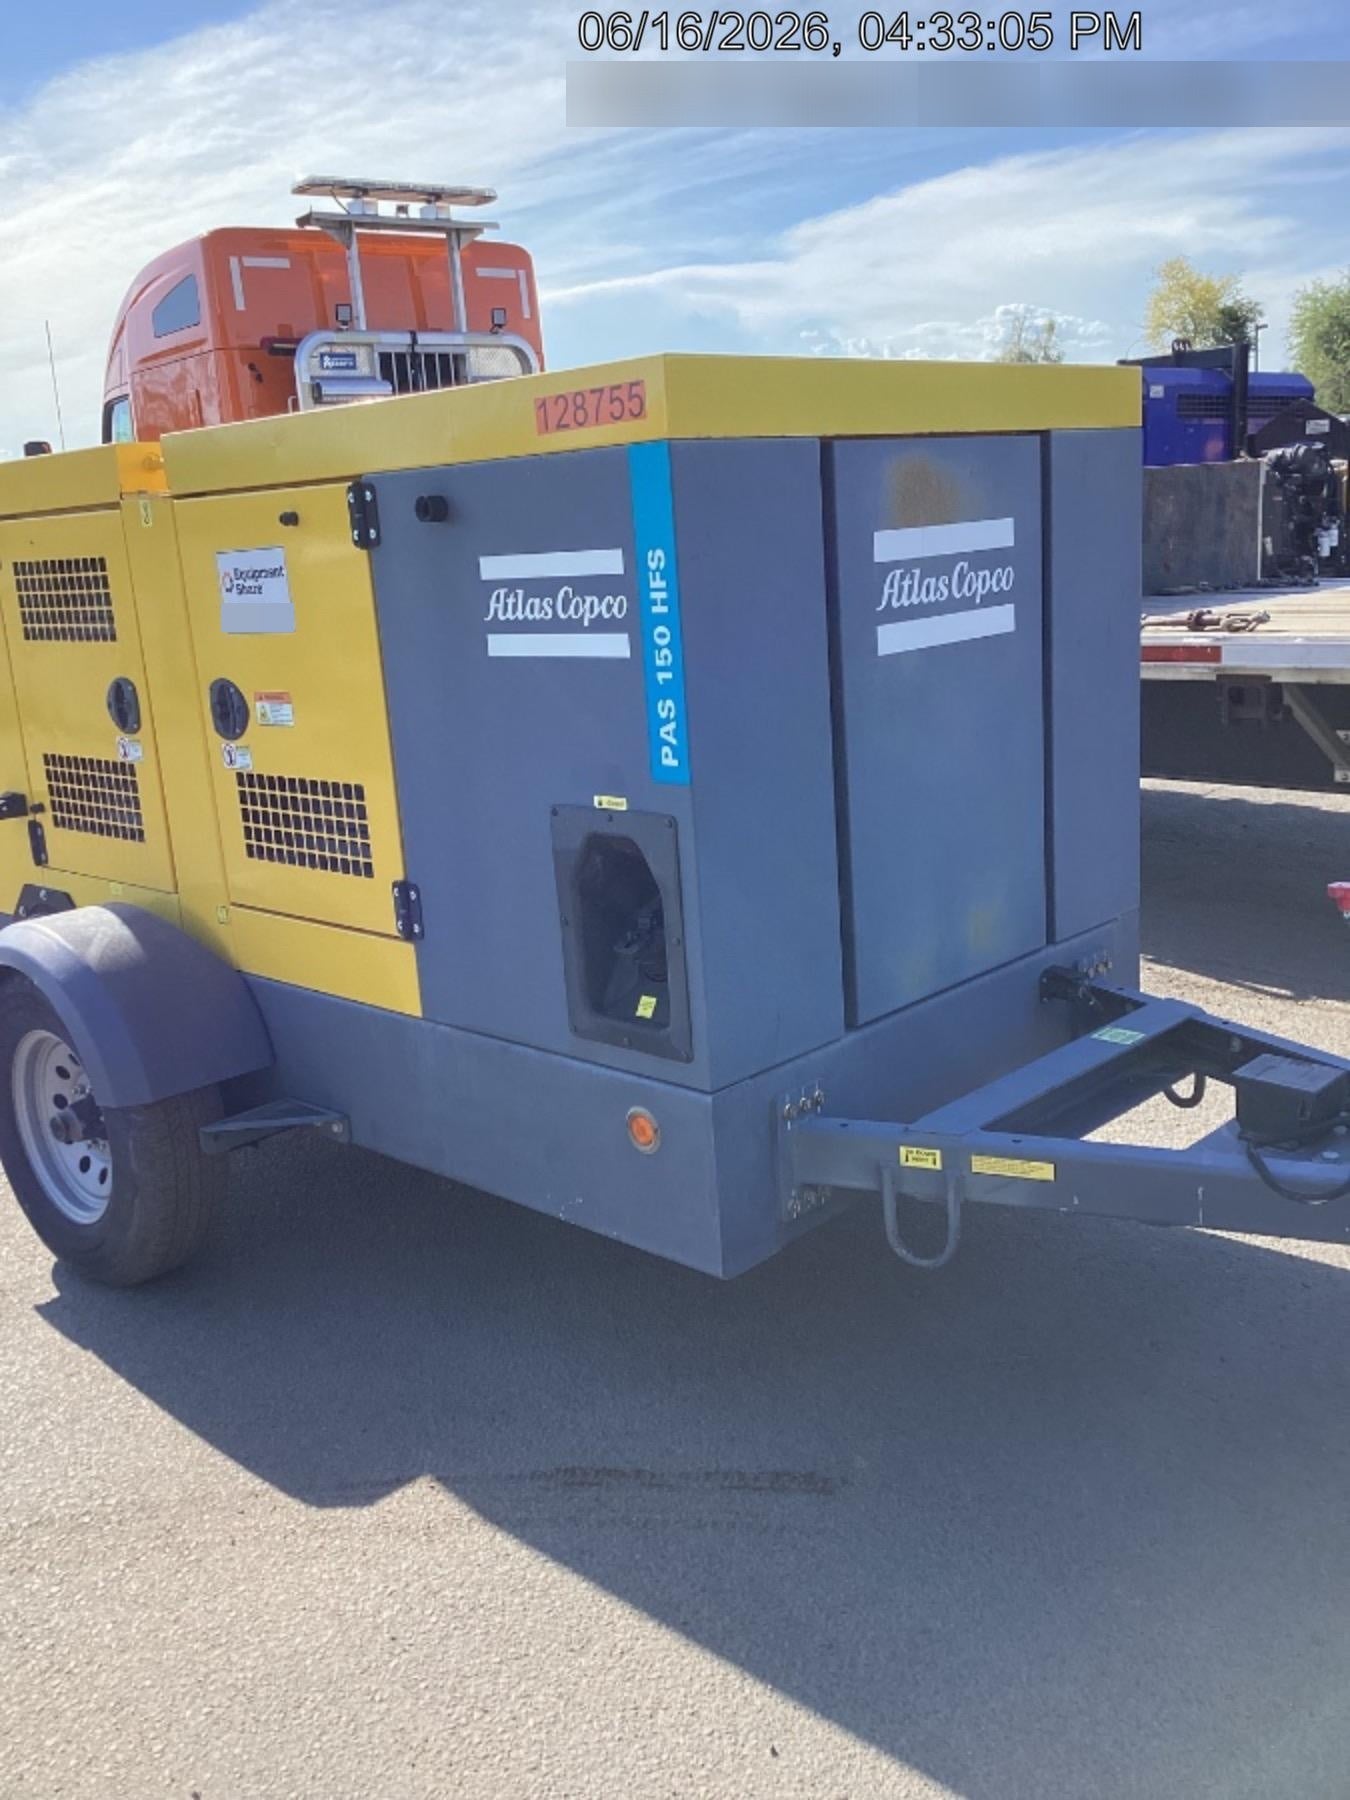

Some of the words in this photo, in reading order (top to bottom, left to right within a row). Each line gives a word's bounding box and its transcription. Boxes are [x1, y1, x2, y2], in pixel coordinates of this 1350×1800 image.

[537, 381, 644, 432] 128755
[484, 587, 553, 621] Atlas
[556, 585, 628, 627] Copco
[647, 548, 669, 614] HFS
[875, 567, 949, 612] Atlas
[951, 561, 1015, 604] Copco
[653, 625, 673, 685] 150
[657, 698, 679, 767] PAS
